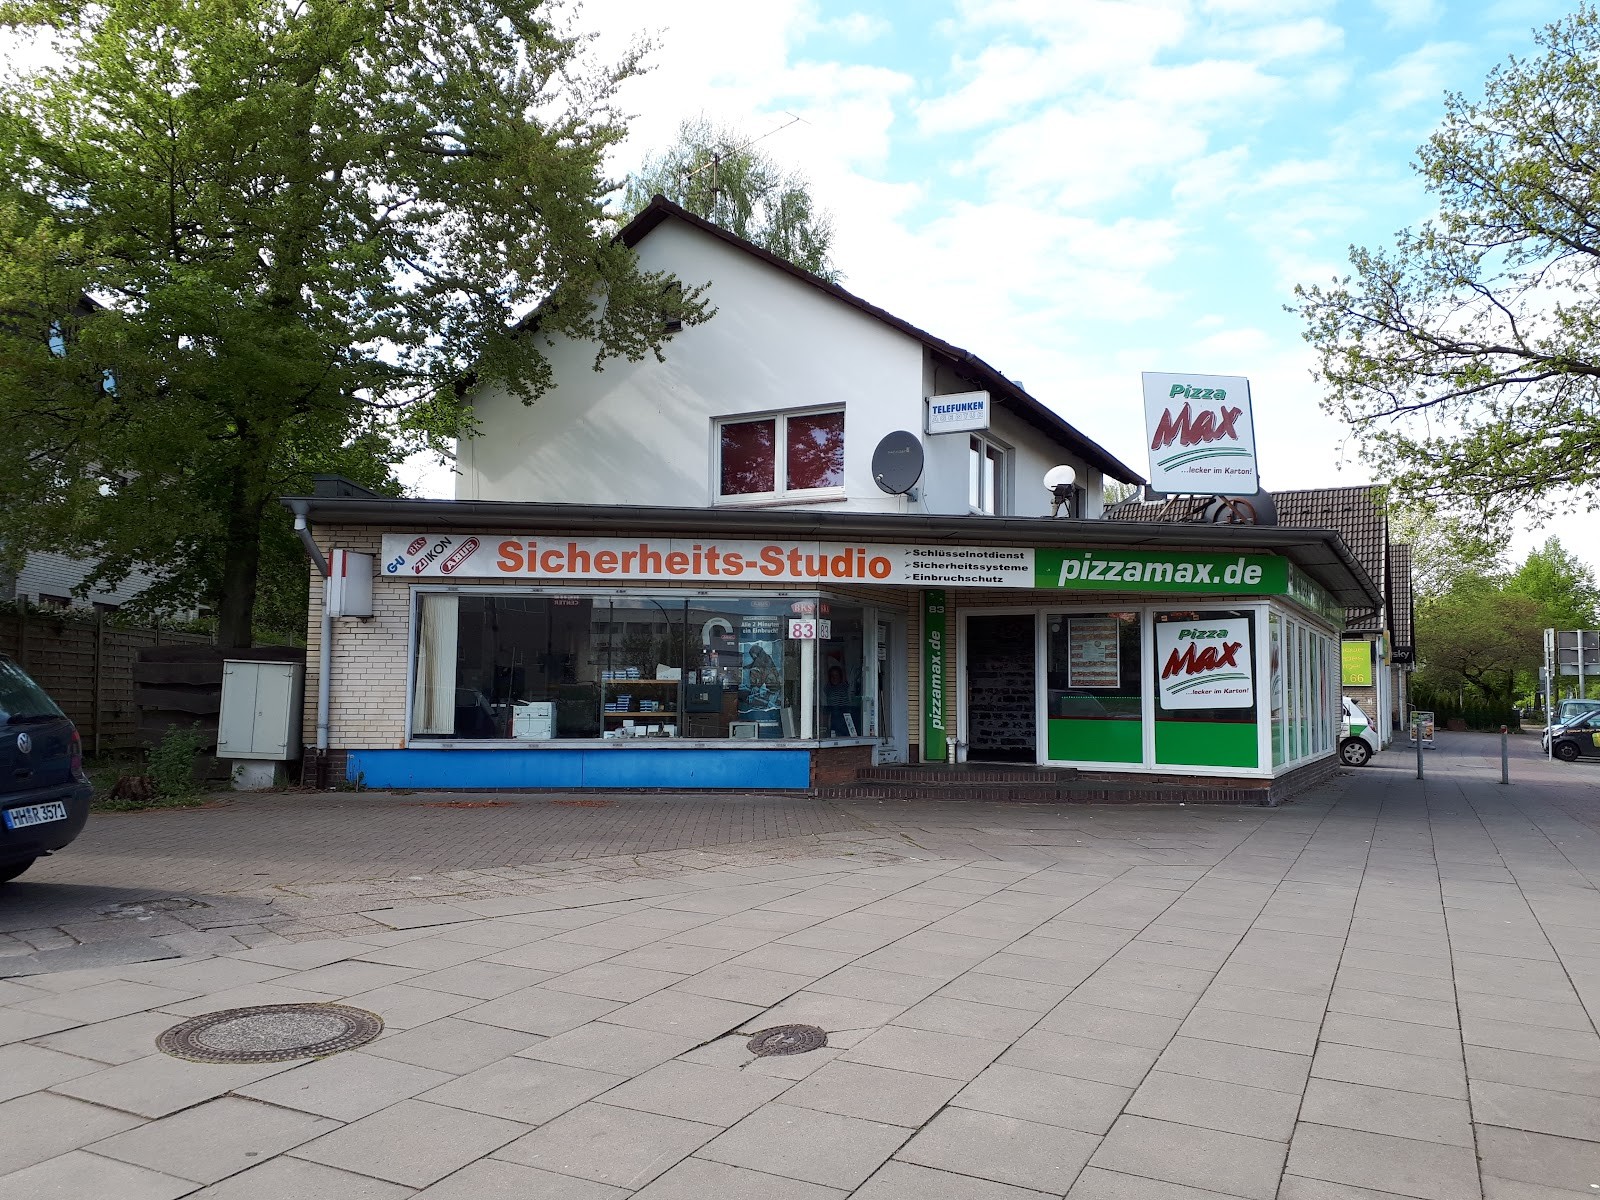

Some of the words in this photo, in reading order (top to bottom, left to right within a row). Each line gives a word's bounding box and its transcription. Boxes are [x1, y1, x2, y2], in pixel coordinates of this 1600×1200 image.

[1169, 384, 1227, 401] Pizza
[932, 401, 984, 414] TELEFUNKEN
[1151, 401, 1243, 451] Max
[1224, 467, 1253, 475] Karton!
[408, 537, 427, 557] BKS
[912, 549, 1025, 560] Schlüsselnotdienst
[445, 541, 476, 571] ABUS
[496, 541, 892, 579] Sicherheits-Studio
[912, 561, 1029, 572] Sicherheitssysteme
[1058, 552, 1262, 587] pizzamax.de
[912, 573, 1004, 583] Einbruchschutz
[792, 623, 814, 639] 83
[820, 624, 829, 639] 83
[1178, 628, 1229, 640] Pizza
[1161, 641, 1243, 680] Max
[1392, 650, 1410, 659] sky
[929, 631, 945, 730] pizzamax.de
[1350, 673, 1364, 683] 66
[11, 807, 29, 826] HH
[42, 804, 65, 820] 3571
